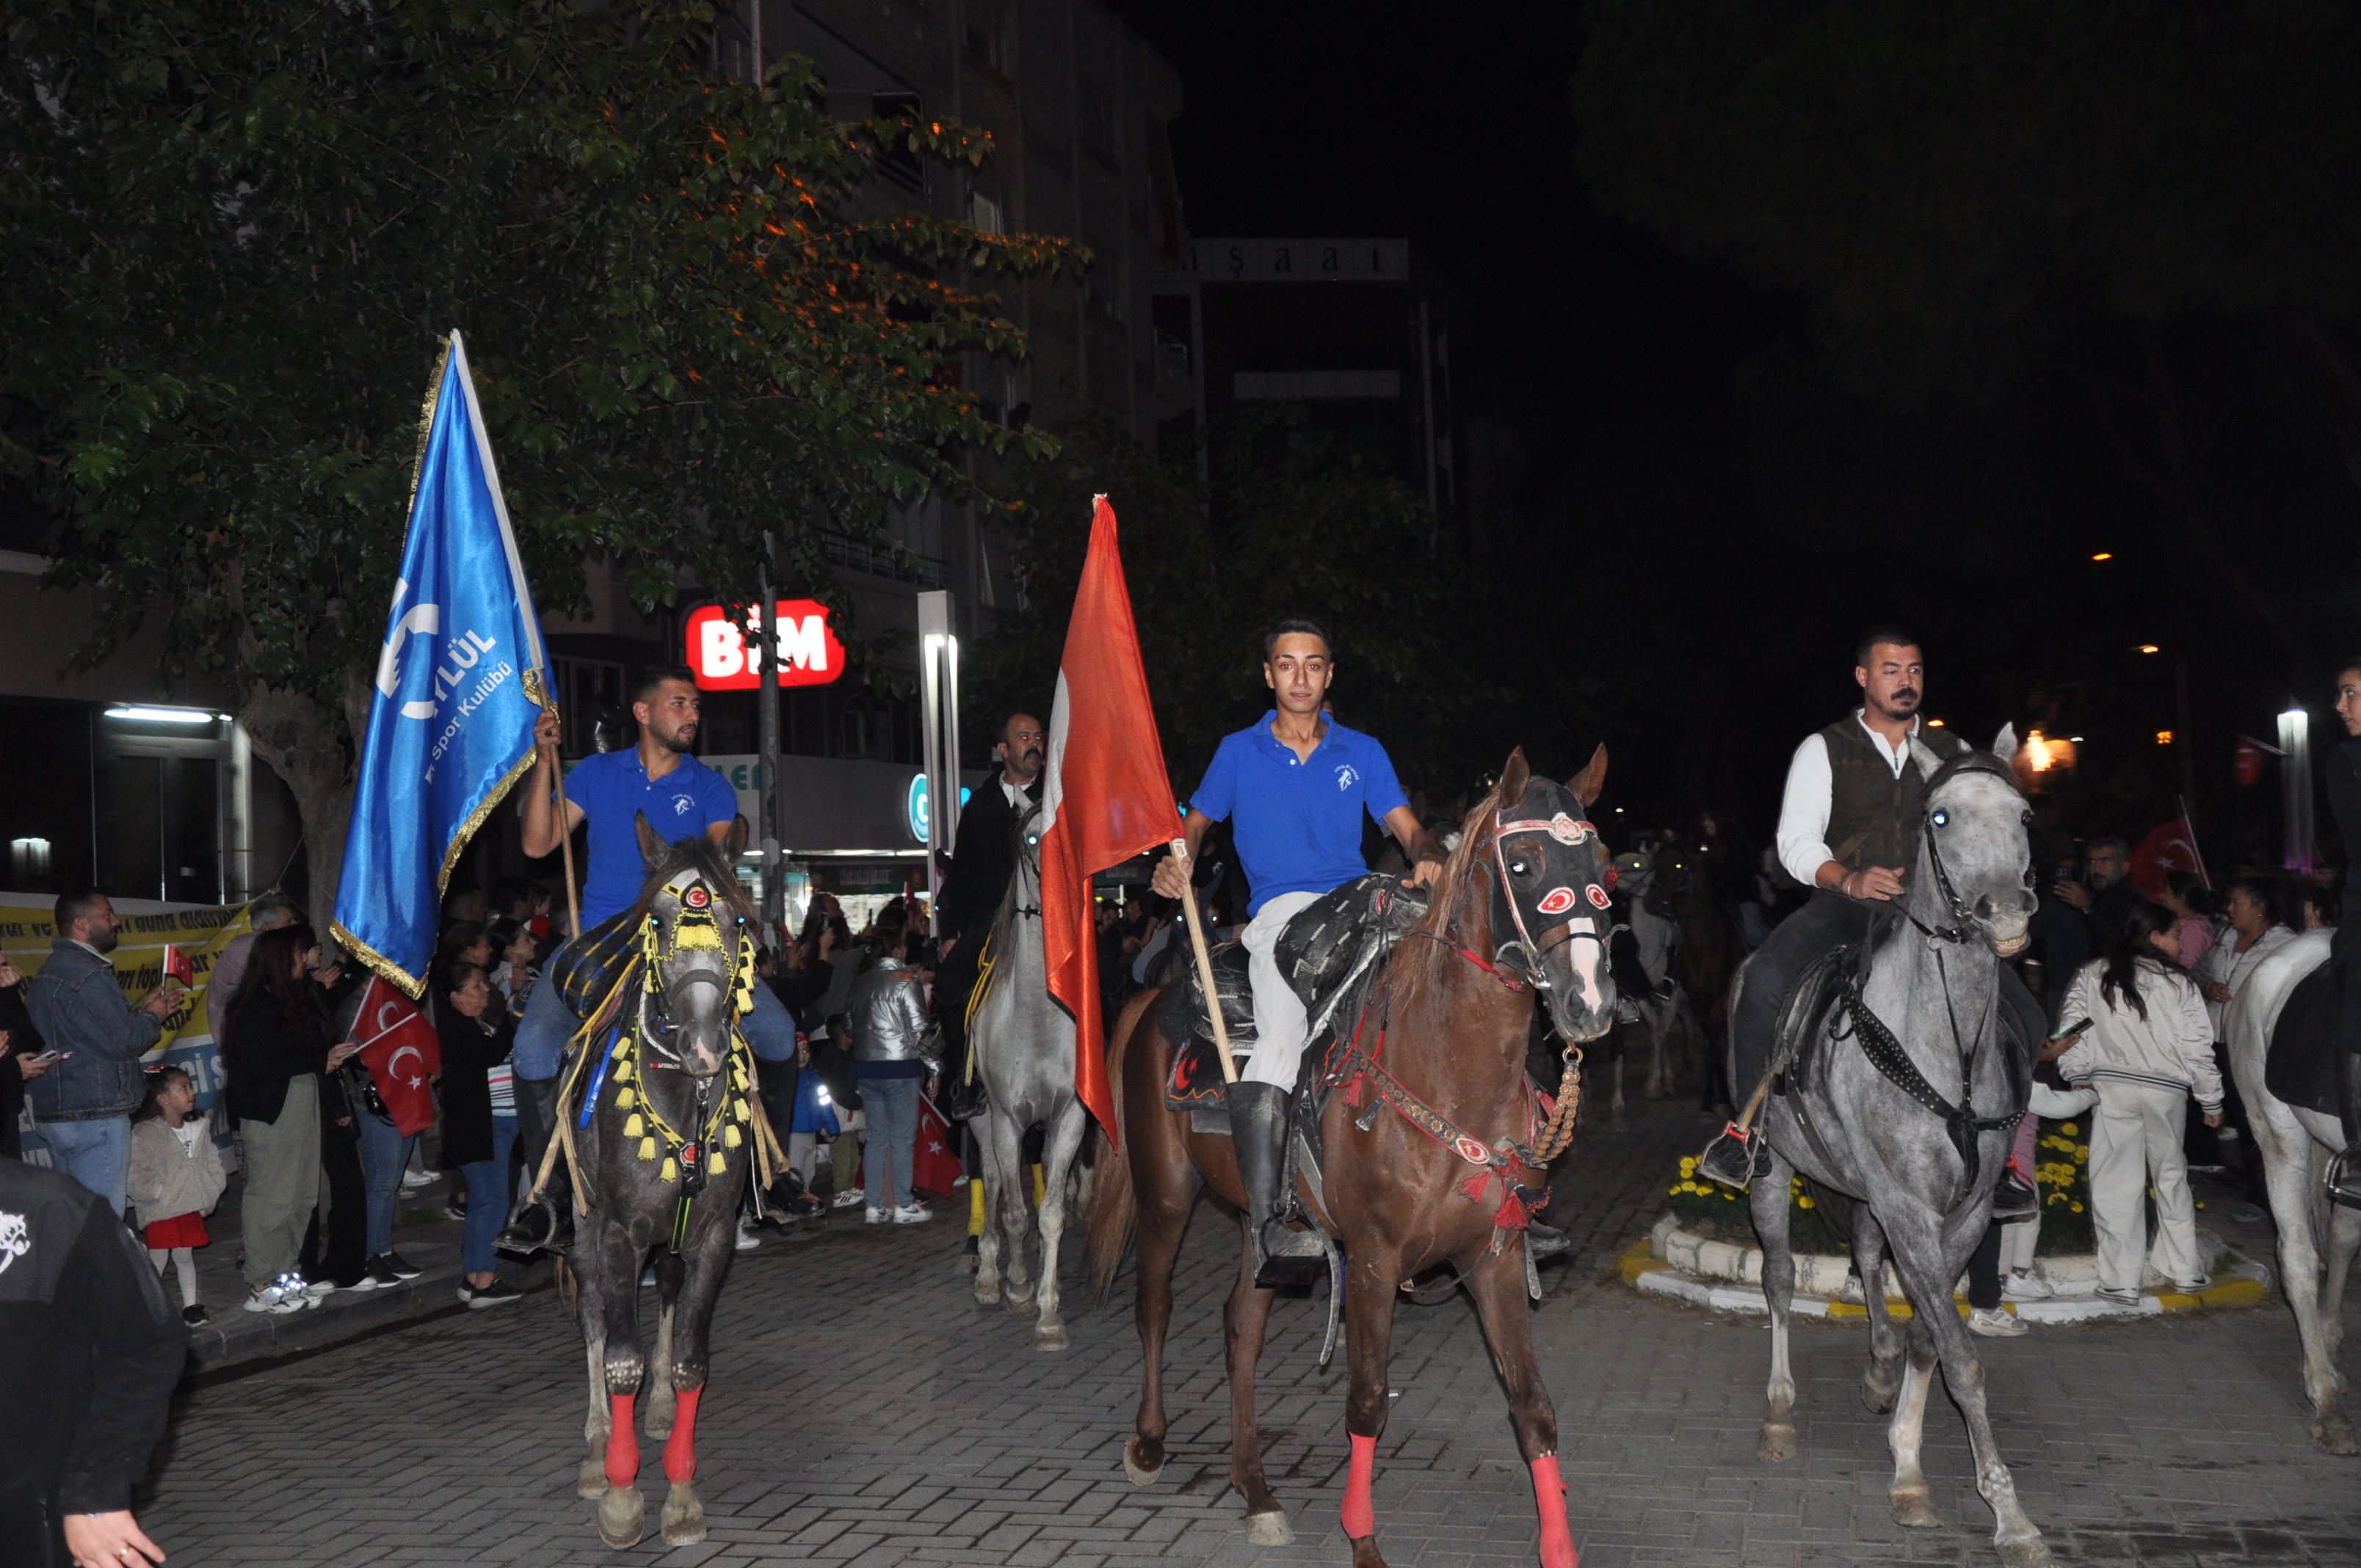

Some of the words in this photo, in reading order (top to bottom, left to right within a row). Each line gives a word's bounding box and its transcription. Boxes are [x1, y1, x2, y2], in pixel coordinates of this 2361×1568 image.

[432, 716, 462, 761] Spor
[457, 661, 513, 717] Kulübü
[434, 629, 498, 718] YLÜL
